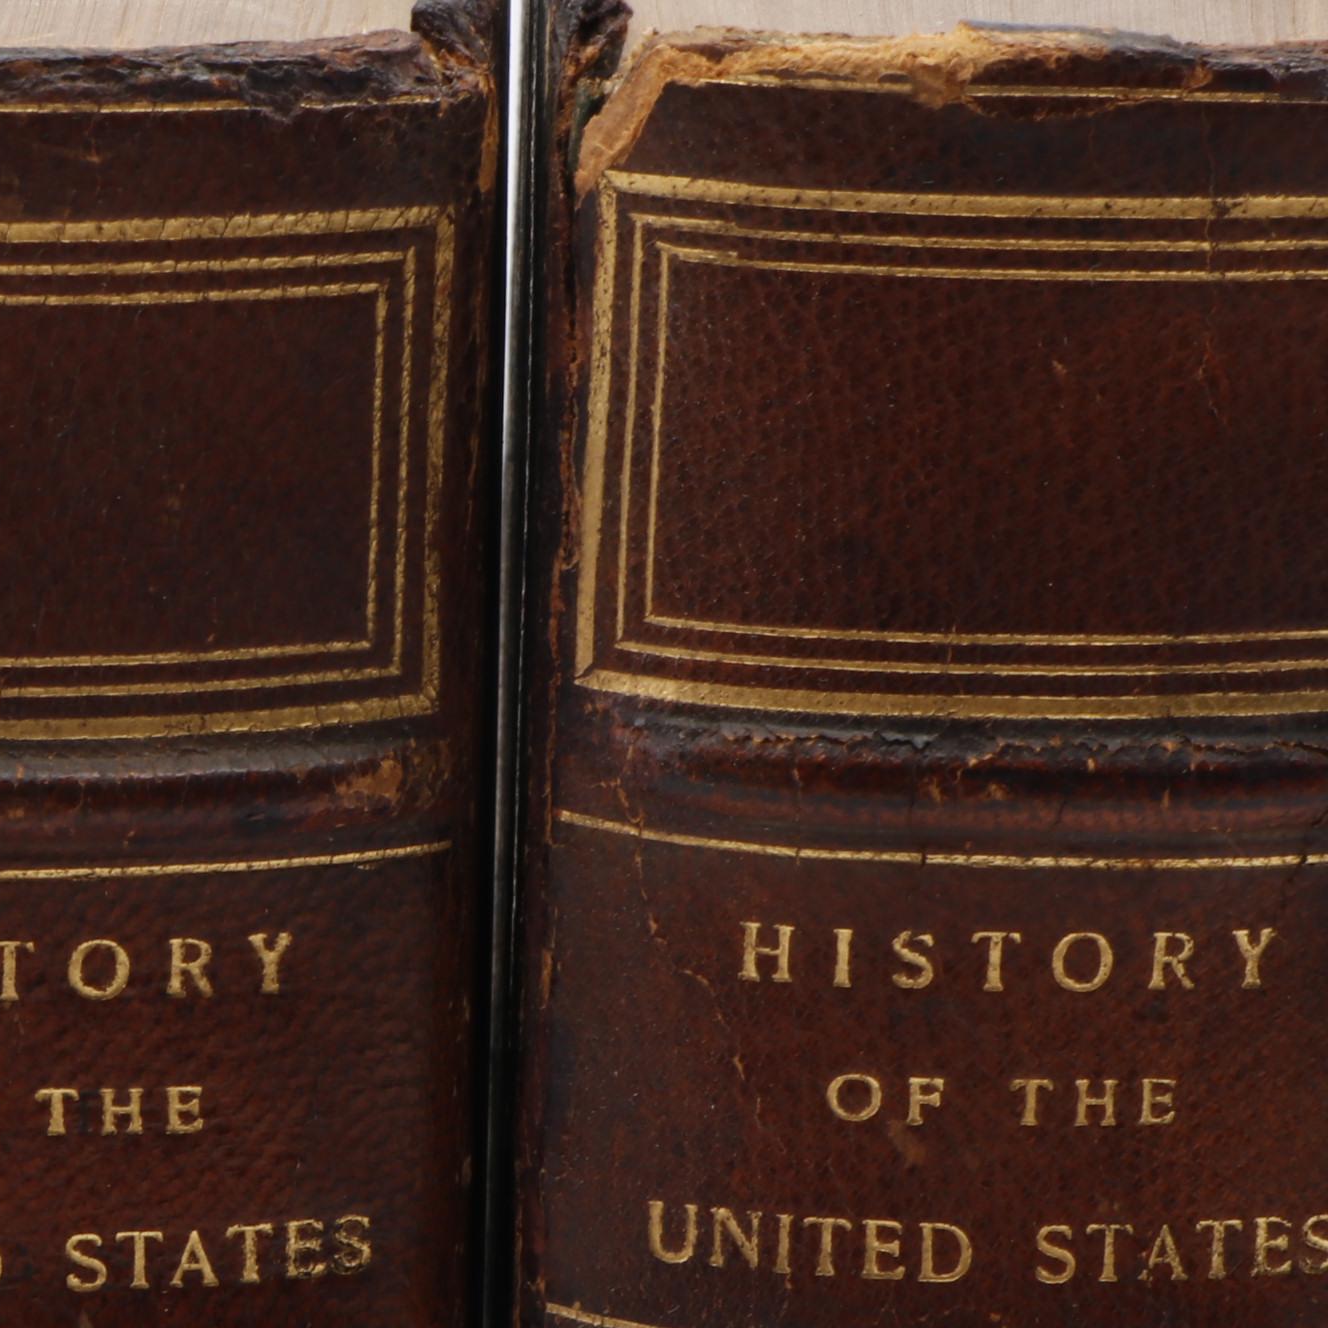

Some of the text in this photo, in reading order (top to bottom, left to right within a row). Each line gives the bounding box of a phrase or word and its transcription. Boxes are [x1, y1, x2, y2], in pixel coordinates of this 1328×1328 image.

[737, 920, 1277, 993] HISTORY
[33, 1084, 205, 1135] THE
[825, 1072, 1178, 1127] OF THE
[64, 1213, 372, 1290] STATES
[647, 1199, 974, 1284] UNITED
